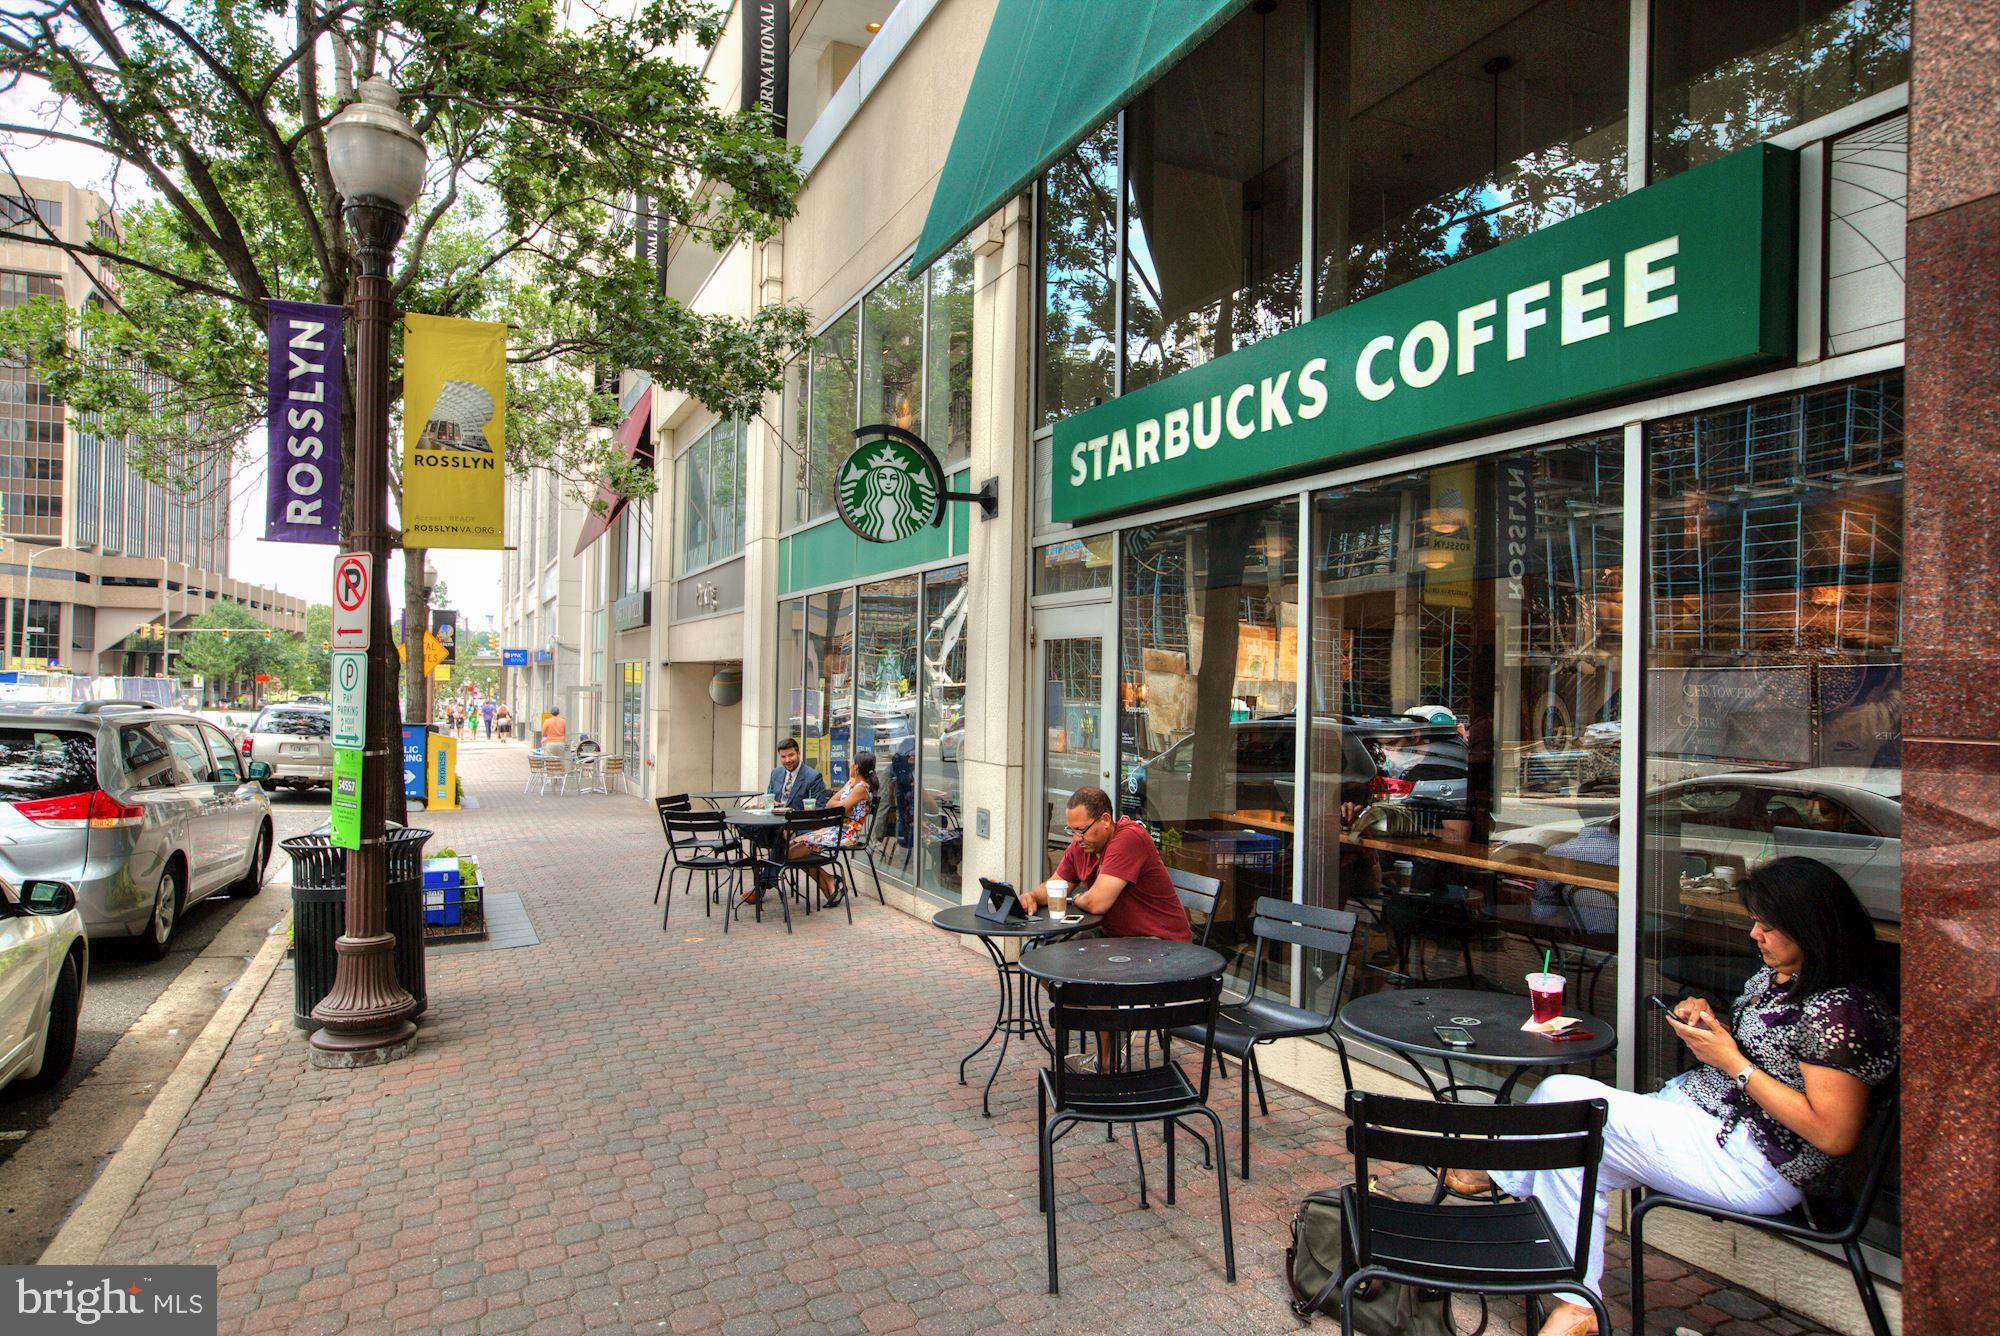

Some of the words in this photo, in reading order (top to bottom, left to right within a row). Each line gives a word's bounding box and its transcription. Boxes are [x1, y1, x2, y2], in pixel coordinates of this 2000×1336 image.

[647, 233, 658, 267] ONAL
[1069, 358, 1328, 487] STARBUCKS
[1354, 235, 1680, 402] COFFEE
[286, 319, 325, 525] ROSSLYN
[414, 454, 495, 470] ROSSLYN
[343, 693, 353, 701] PAY
[337, 705, 359, 716] PARKING
[403, 745, 419, 754] LIC
[338, 779, 356, 792] 54557
